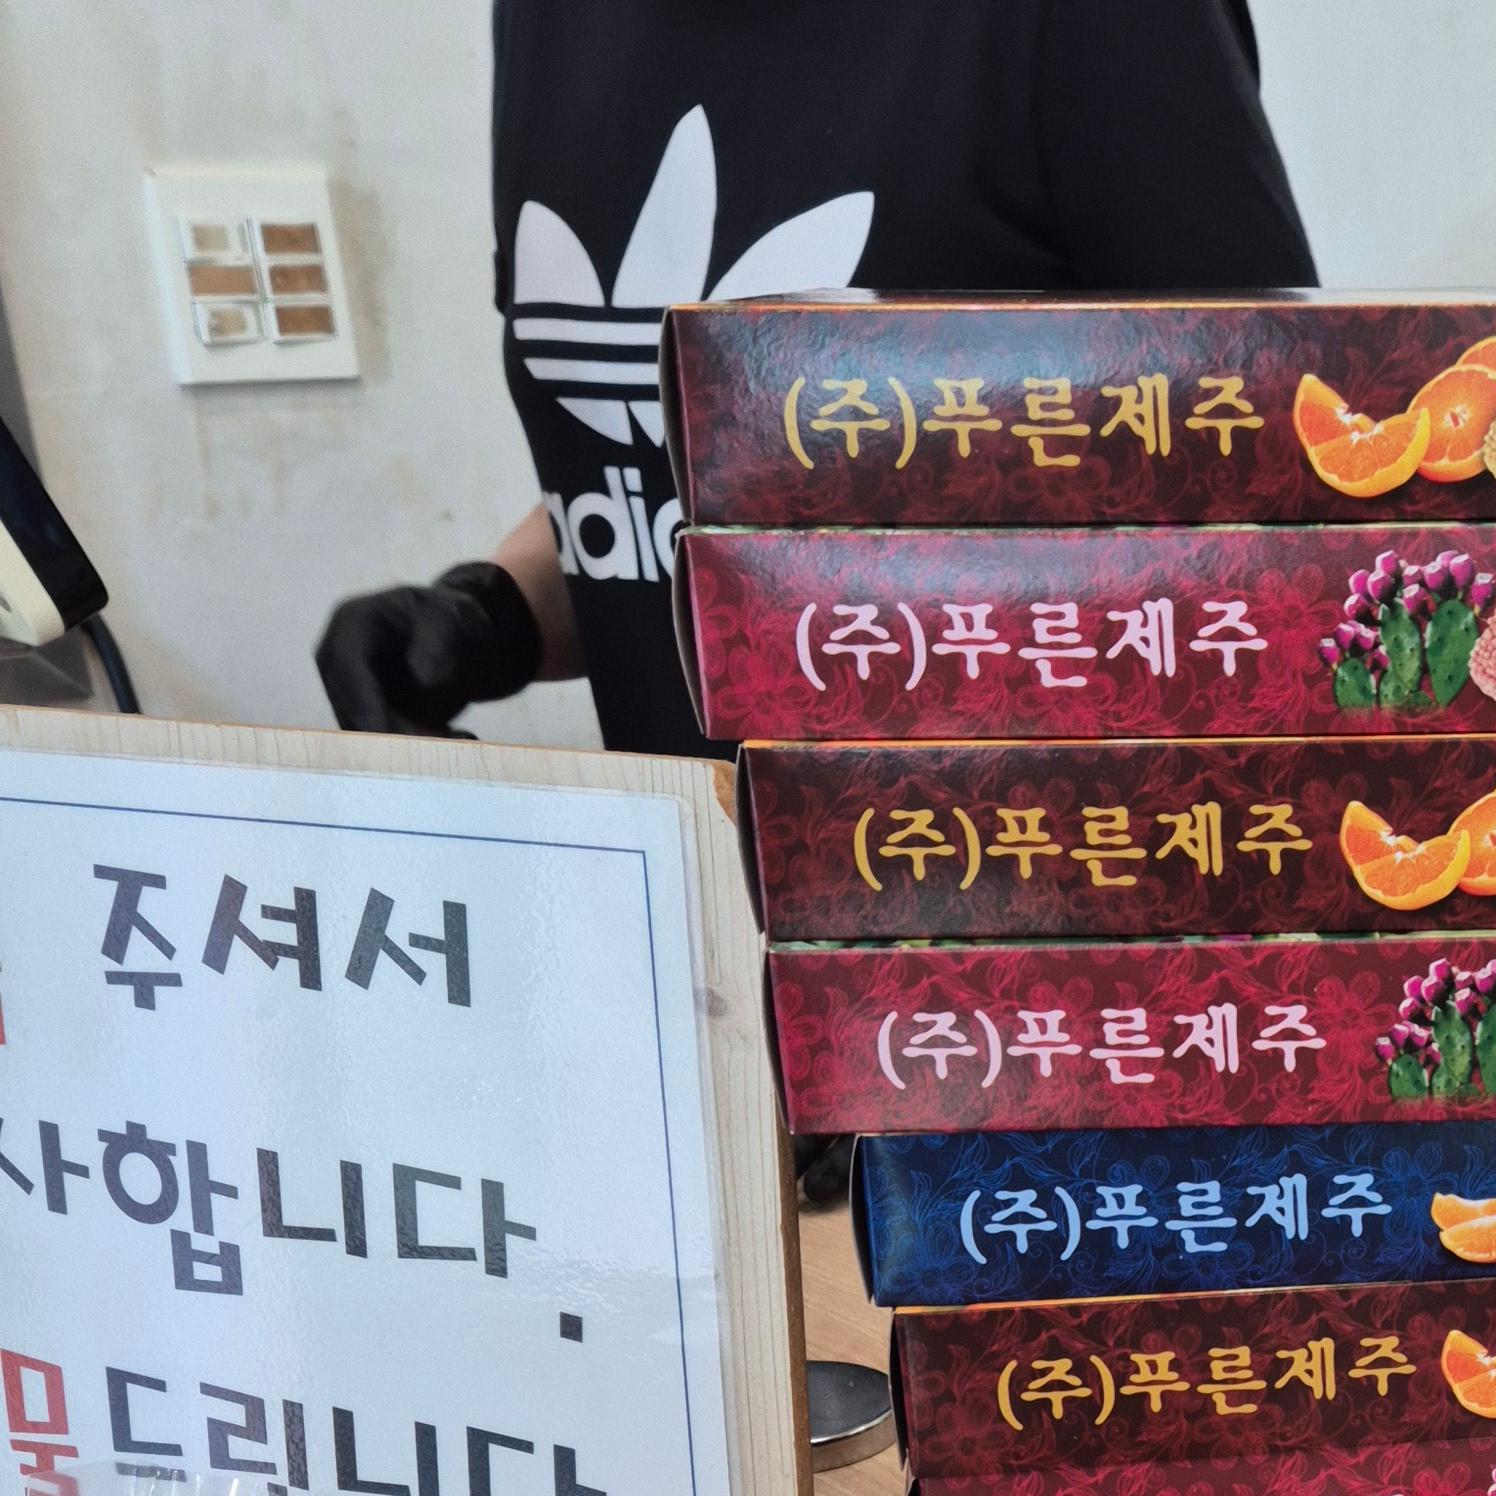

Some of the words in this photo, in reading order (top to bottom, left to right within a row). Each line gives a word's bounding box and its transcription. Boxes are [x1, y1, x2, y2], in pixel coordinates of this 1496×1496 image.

[784, 373, 1265, 470] (주)푸른제주
[796, 598, 1268, 691] (주)푸른제주
[853, 801, 1314, 892] (주)푸른제주
[93, 863, 471, 1011] 주셔서
[877, 1002, 1327, 1089] (주)푸른제주
[959, 1172, 1393, 1265] (주)푸른제주
[998, 1335, 1417, 1431] (주)푸른제주
